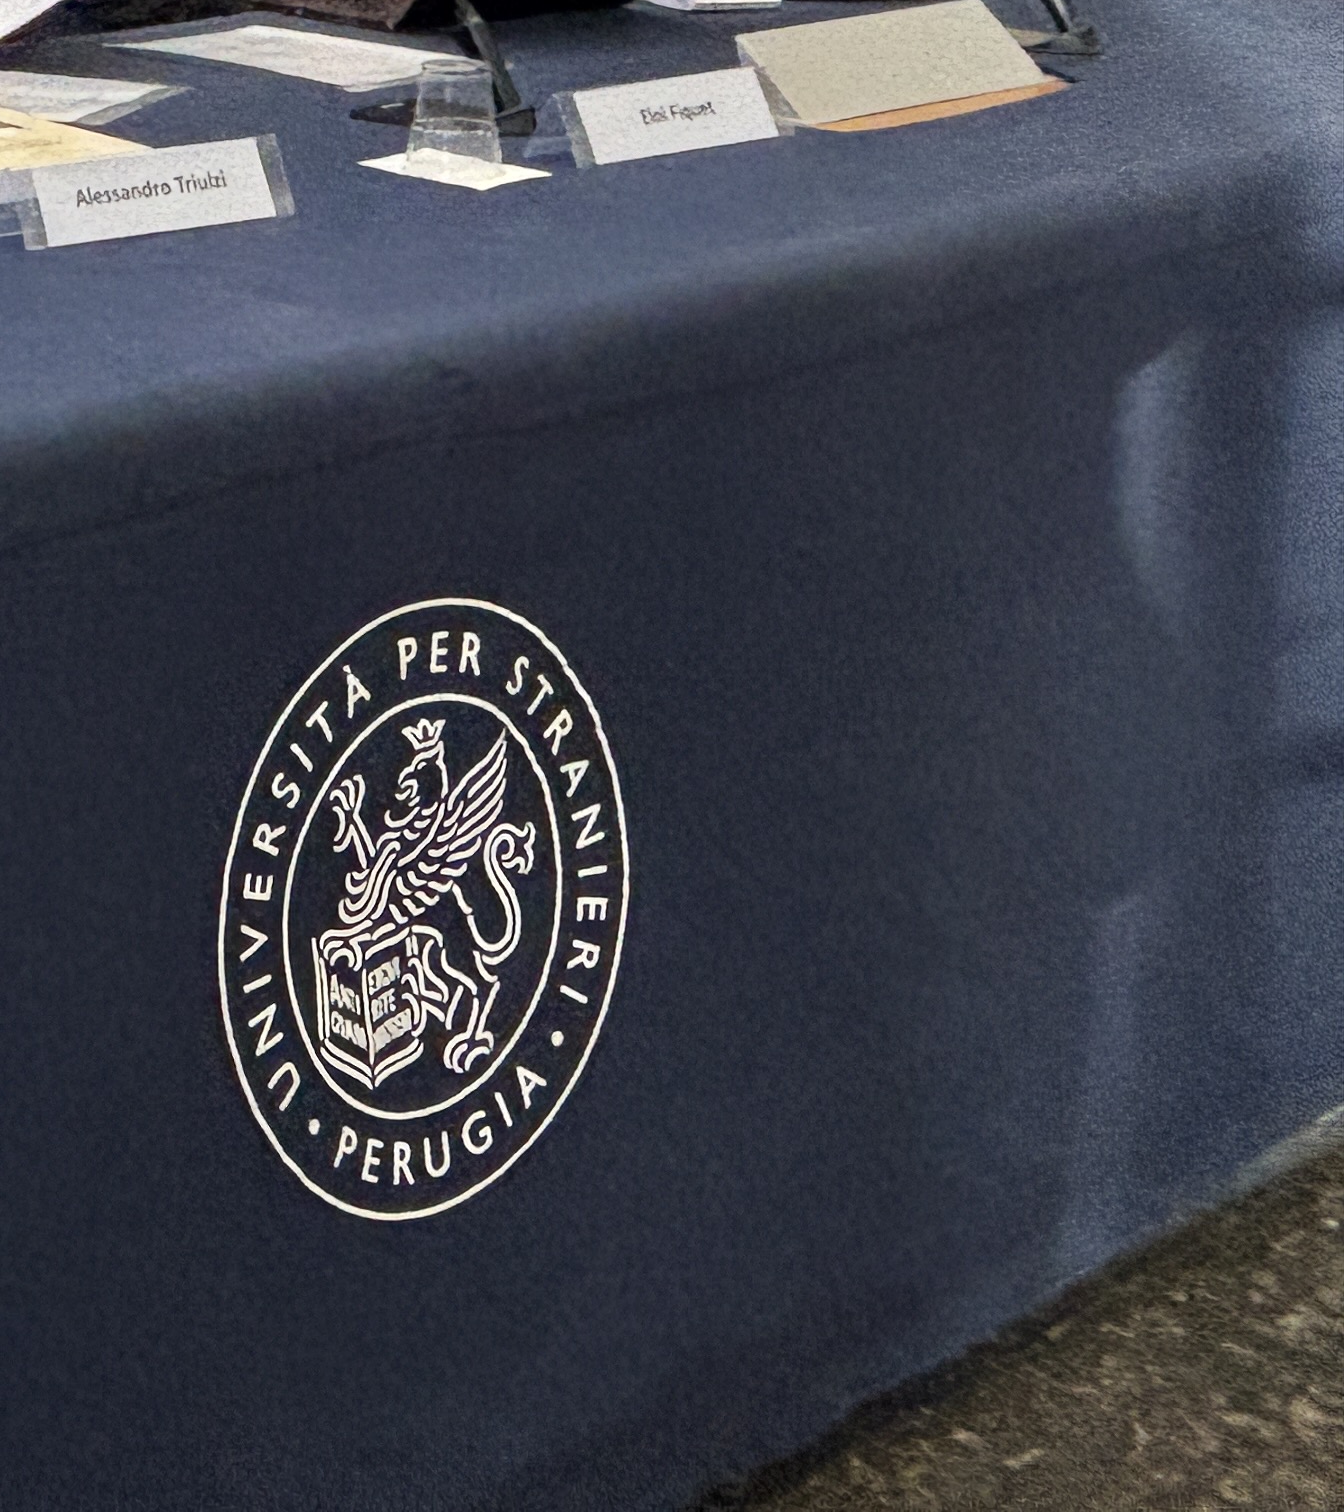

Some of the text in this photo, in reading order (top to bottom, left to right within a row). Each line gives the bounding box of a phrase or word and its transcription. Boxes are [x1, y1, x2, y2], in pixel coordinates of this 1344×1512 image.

[76, 180, 172, 208] Alessandro
[240, 631, 610, 1111] UNIVERSITÀ PER STRANIERI
[333, 1063, 548, 1186] PERUGIA
